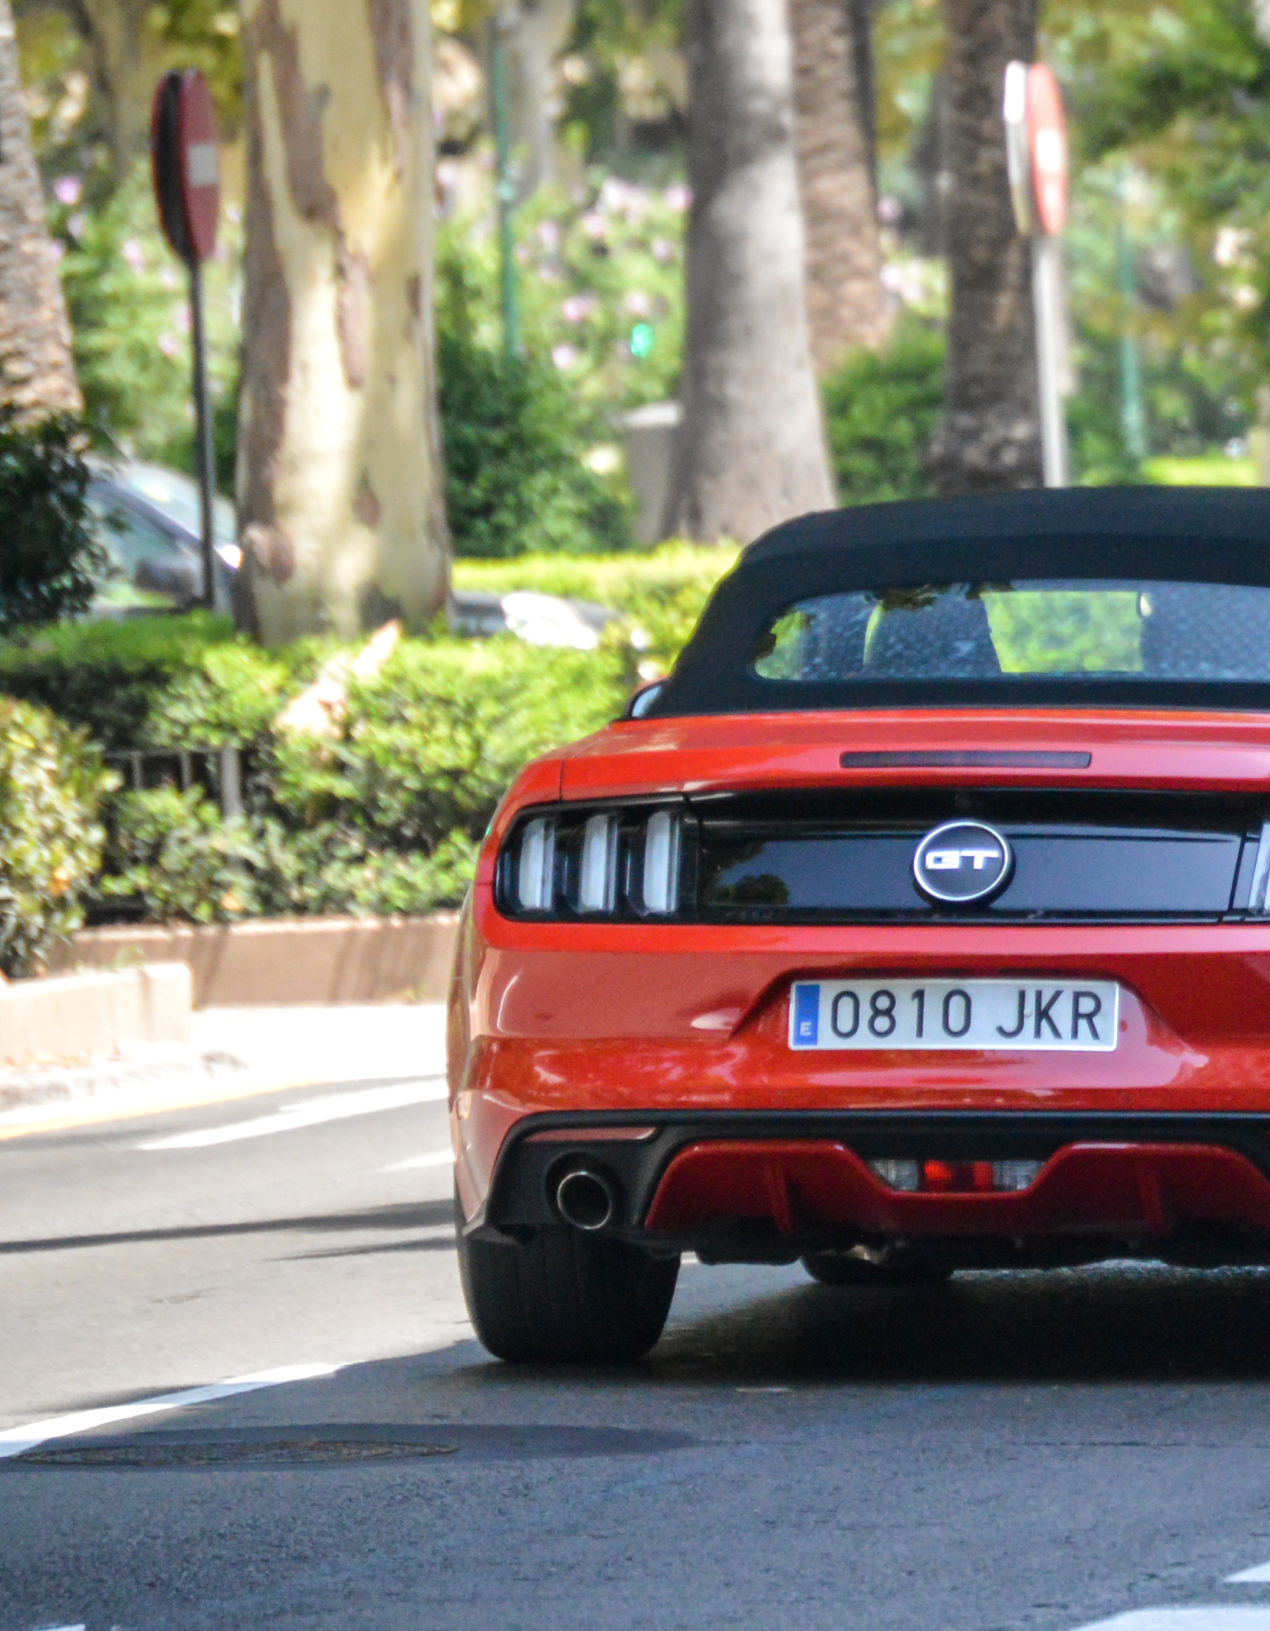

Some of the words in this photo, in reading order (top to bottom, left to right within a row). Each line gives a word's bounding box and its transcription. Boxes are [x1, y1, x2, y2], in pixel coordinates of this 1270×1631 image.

[925, 849, 1000, 870] GT
[830, 988, 973, 1039] 0810
[995, 989, 1103, 1041] JKR
[800, 1021, 812, 1036] E
